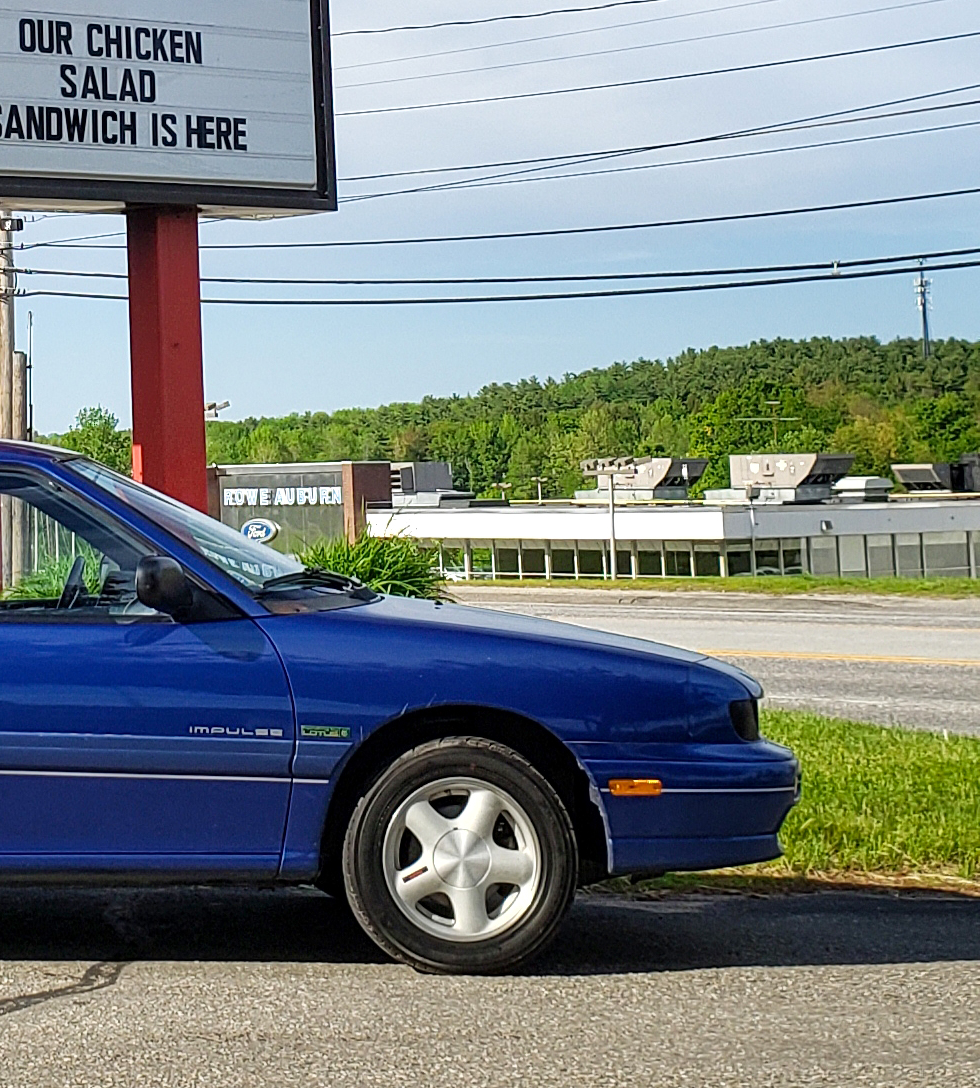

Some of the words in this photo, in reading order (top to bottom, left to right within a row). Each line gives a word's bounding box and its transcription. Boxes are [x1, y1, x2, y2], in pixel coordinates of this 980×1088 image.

[19, 18, 73, 55] OUR
[87, 23, 203, 64] CHICKEN
[60, 64, 156, 103] SALAD
[152, 113, 177, 147] IS
[186, 114, 248, 151] HERE
[223, 488, 270, 506] ROWE
[274, 486, 342, 506] AUBURN
[247, 524, 267, 539] Ford
